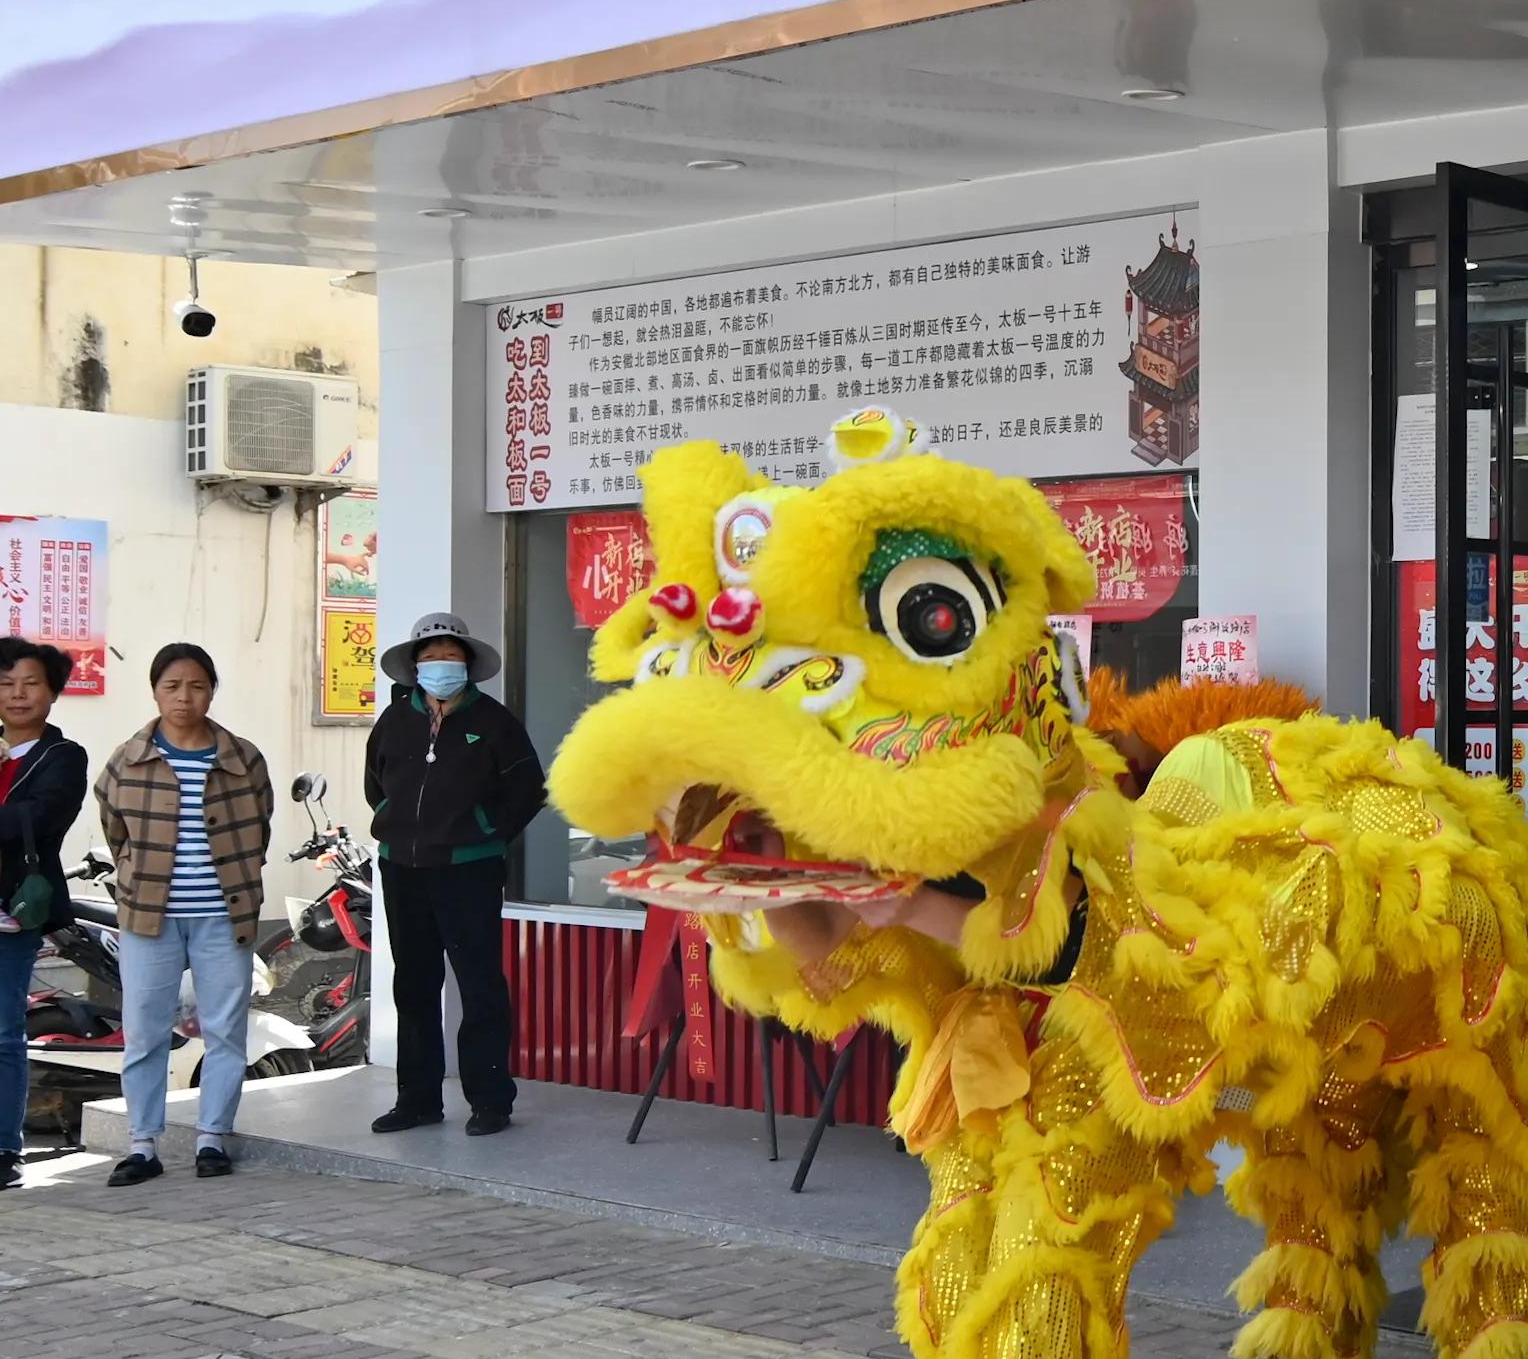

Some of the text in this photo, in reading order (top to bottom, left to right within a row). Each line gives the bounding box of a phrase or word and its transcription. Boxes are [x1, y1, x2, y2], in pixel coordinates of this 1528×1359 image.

[506, 337, 527, 506] 吃太和板面
[529, 334, 551, 502] 到太板一号
